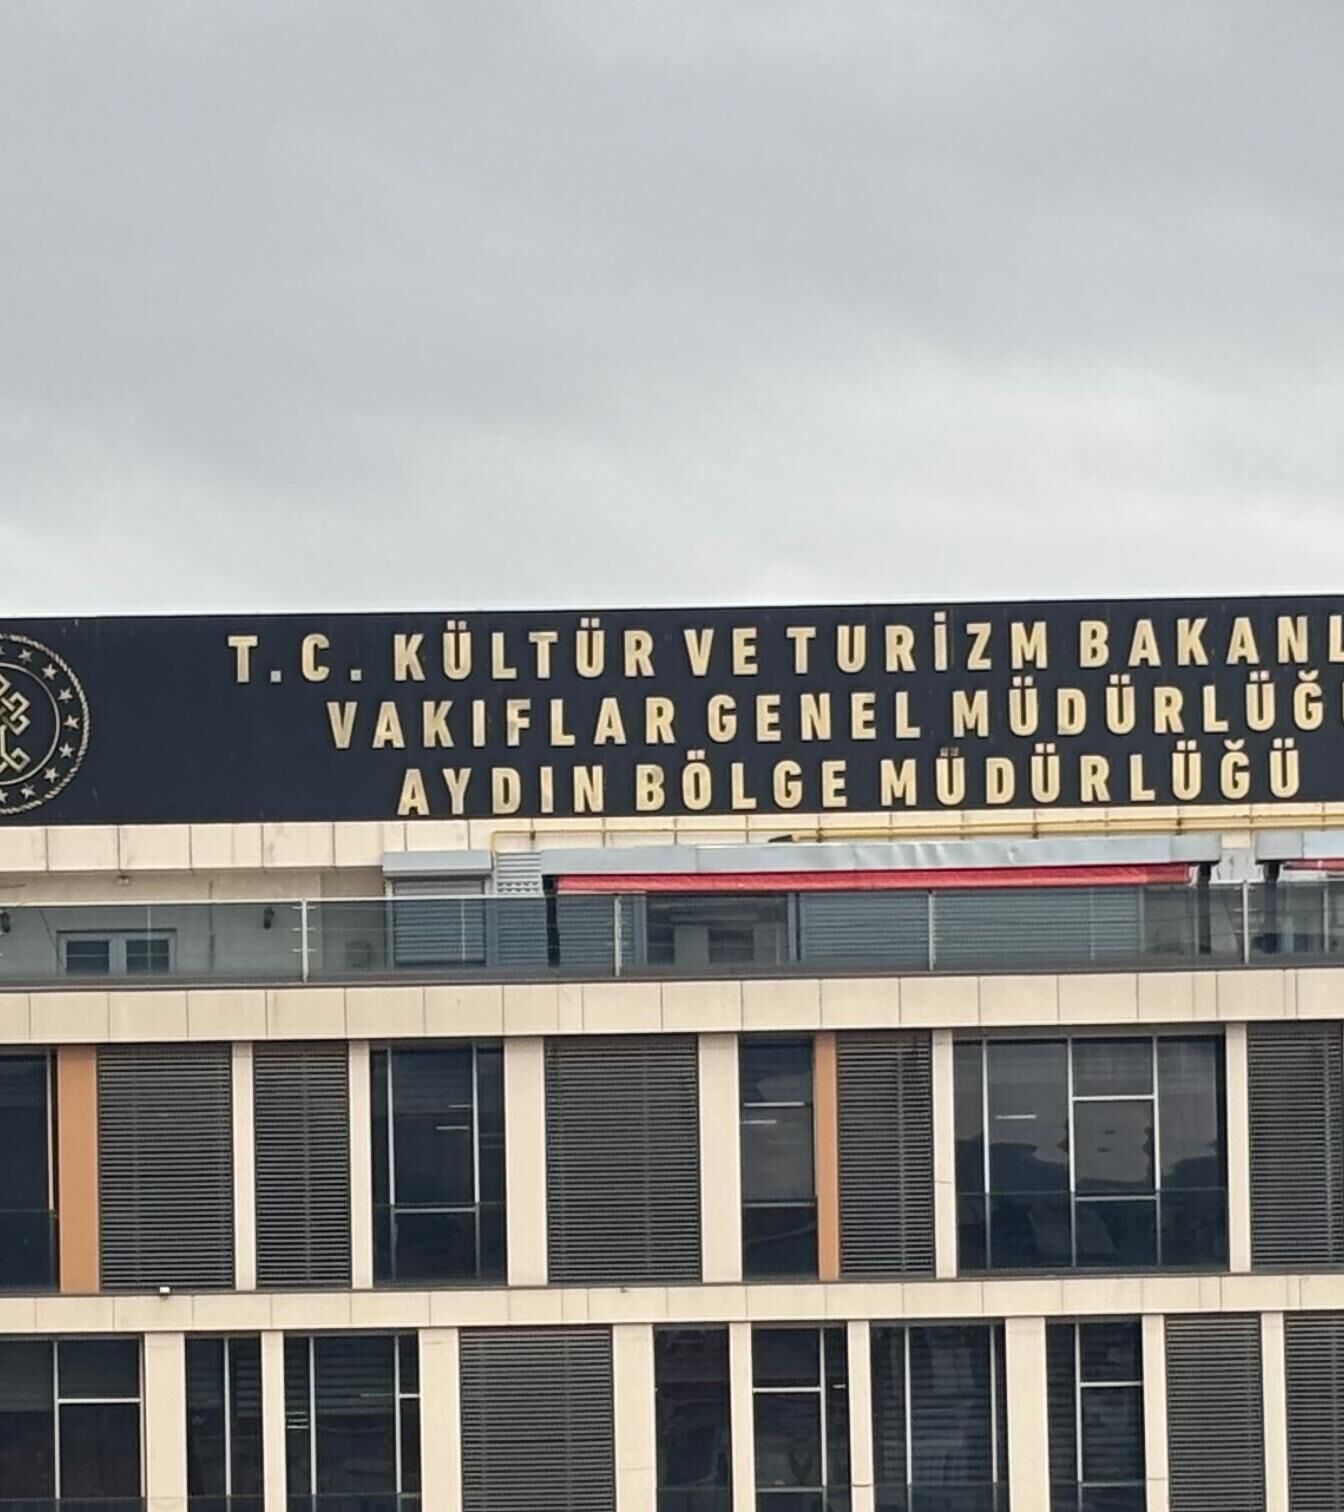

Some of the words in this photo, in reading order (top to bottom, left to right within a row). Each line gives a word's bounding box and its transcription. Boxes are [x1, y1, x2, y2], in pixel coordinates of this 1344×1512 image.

[394, 618, 654, 681] KÜLTÜR
[686, 626, 759, 677] VE
[788, 609, 1048, 675] TURİZM
[328, 696, 676, 749] VAKIFLAR
[707, 691, 919, 743] GENEL
[398, 764, 605, 816] AYDIN
[636, 749, 848, 812] BÖLGE
[880, 737, 1301, 807] MÜDÜRLÜĞÜ
